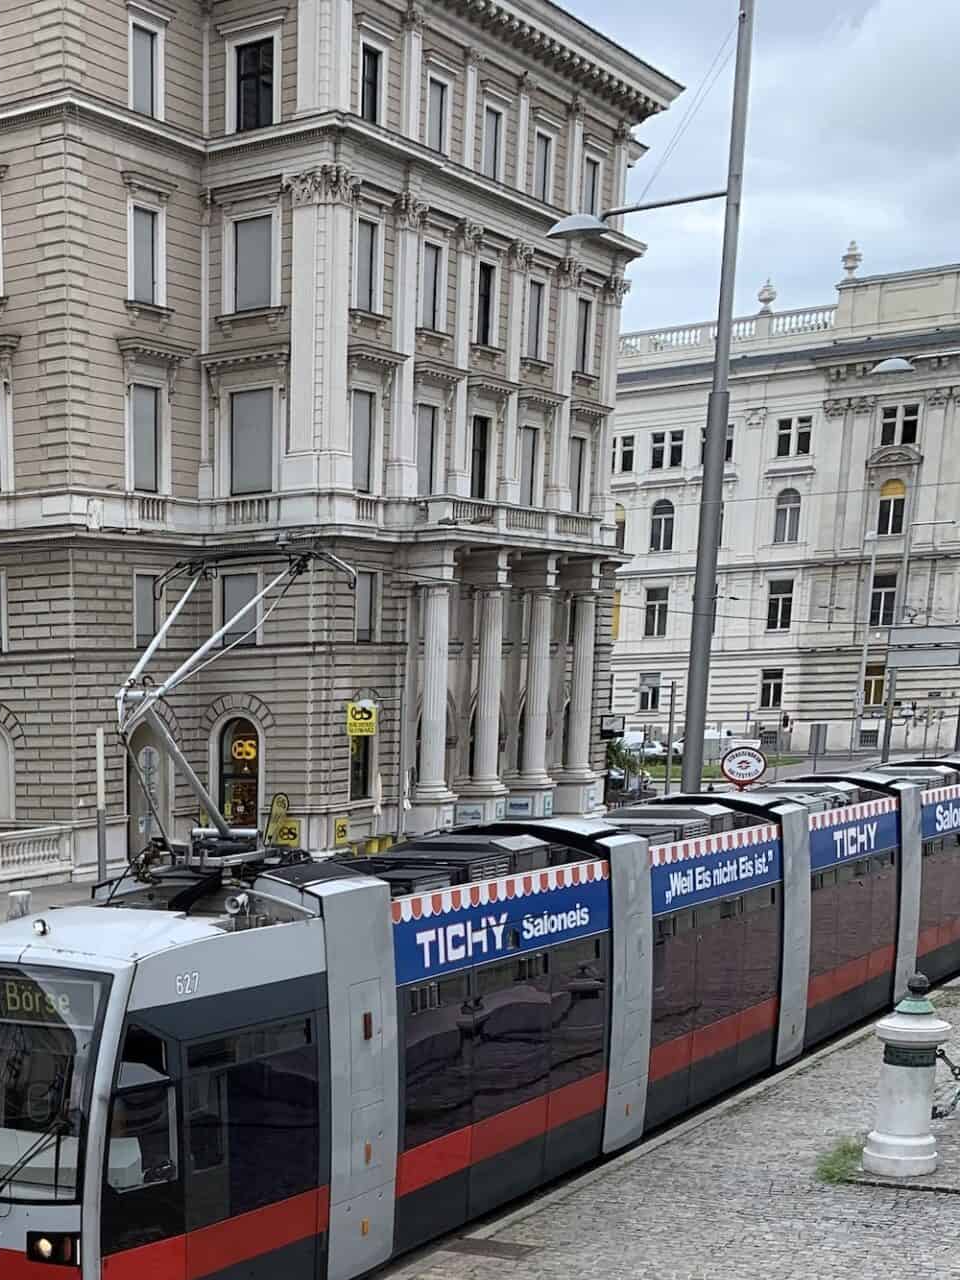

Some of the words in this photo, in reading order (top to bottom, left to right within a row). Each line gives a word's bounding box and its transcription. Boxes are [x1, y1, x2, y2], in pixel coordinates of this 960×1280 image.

[935, 802, 960, 832] Salo
[833, 821, 877, 859] TICHY
[695, 865, 712, 890] Eis
[713, 859, 738, 886] nicht
[739, 855, 754, 878] Eis
[416, 911, 508, 969] TICHY
[522, 903, 590, 940] Saloneis
[5, 980, 72, 1015] Börse
[175, 972, 200, 995] 627
